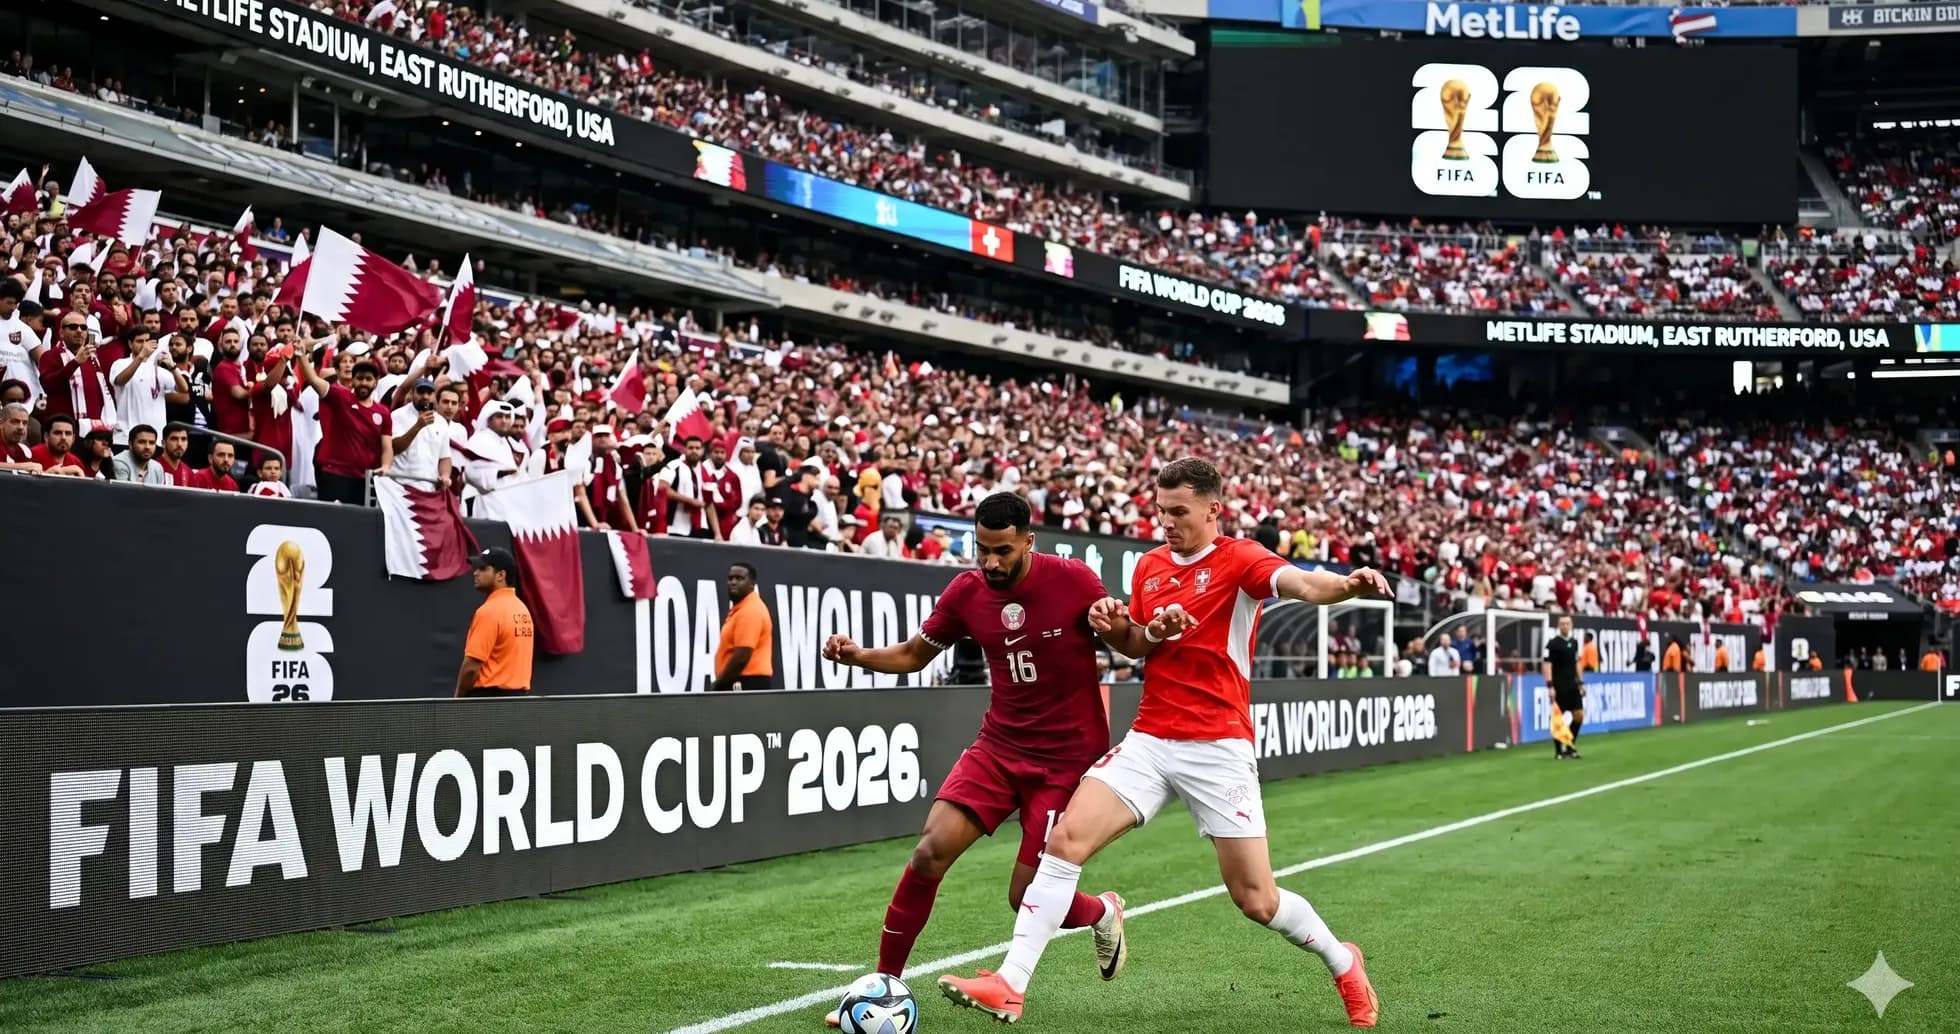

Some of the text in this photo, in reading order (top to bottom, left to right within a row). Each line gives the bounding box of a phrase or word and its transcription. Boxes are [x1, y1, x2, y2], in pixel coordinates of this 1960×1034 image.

[1426, 3, 1580, 41] MetLife
[163, 0, 615, 146] LIFE STADIUM, EAST RUTHERFORD, USA
[1437, 168, 1474, 182] FIFA
[1527, 171, 1565, 185] FIFA
[1119, 265, 1154, 295] FIFA
[1153, 274, 1210, 308] WORLD
[1210, 289, 1242, 315] CUP
[1486, 320, 1890, 350] METLIFE STADIUM, EAST RUTHERFORD, USA
[271, 661, 310, 679] FIFA
[1006, 650, 1038, 683] 16
[1283, 698, 1354, 755] WORLD
[1355, 696, 1391, 747] CUP
[50, 760, 308, 909] FIFA
[324, 743, 624, 872] WORLD
[1044, 809, 1066, 842] 1
